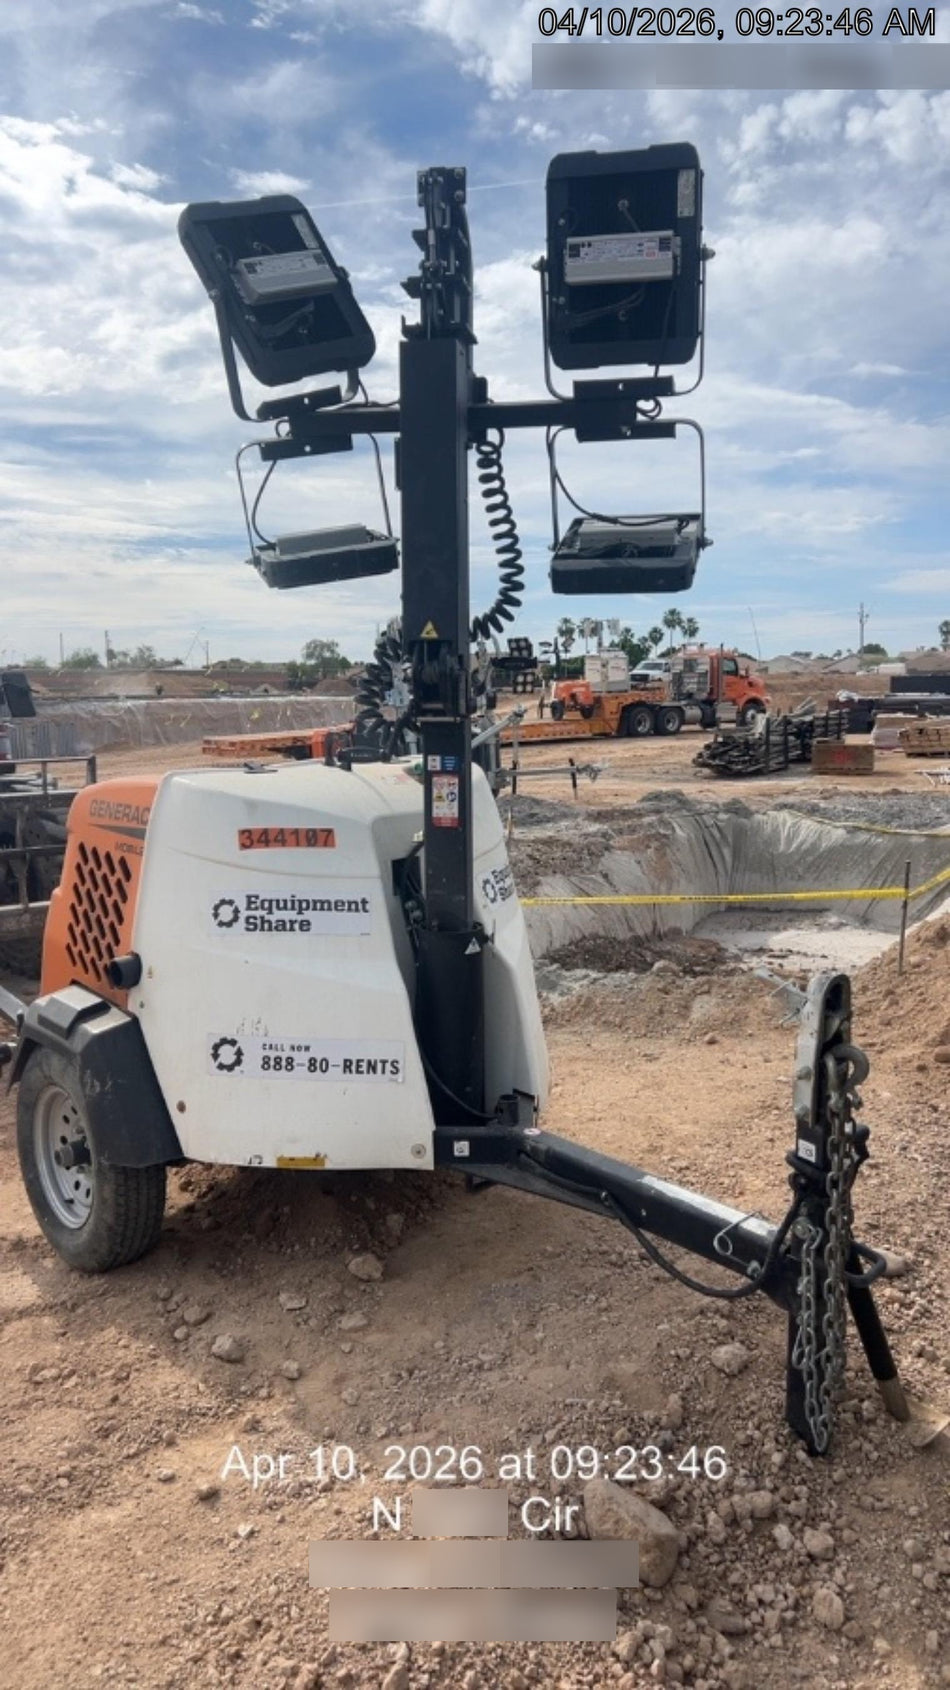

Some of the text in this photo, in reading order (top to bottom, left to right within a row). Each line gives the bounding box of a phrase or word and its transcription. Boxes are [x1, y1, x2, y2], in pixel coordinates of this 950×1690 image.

[89, 799, 151, 826] GENERAC
[239, 828, 333, 849] 344107
[245, 894, 370, 915] Equipment
[244, 915, 312, 933] Share
[261, 1043, 311, 1053] CALL NOW
[260, 1055, 401, 1076] 888-80-RENTS
